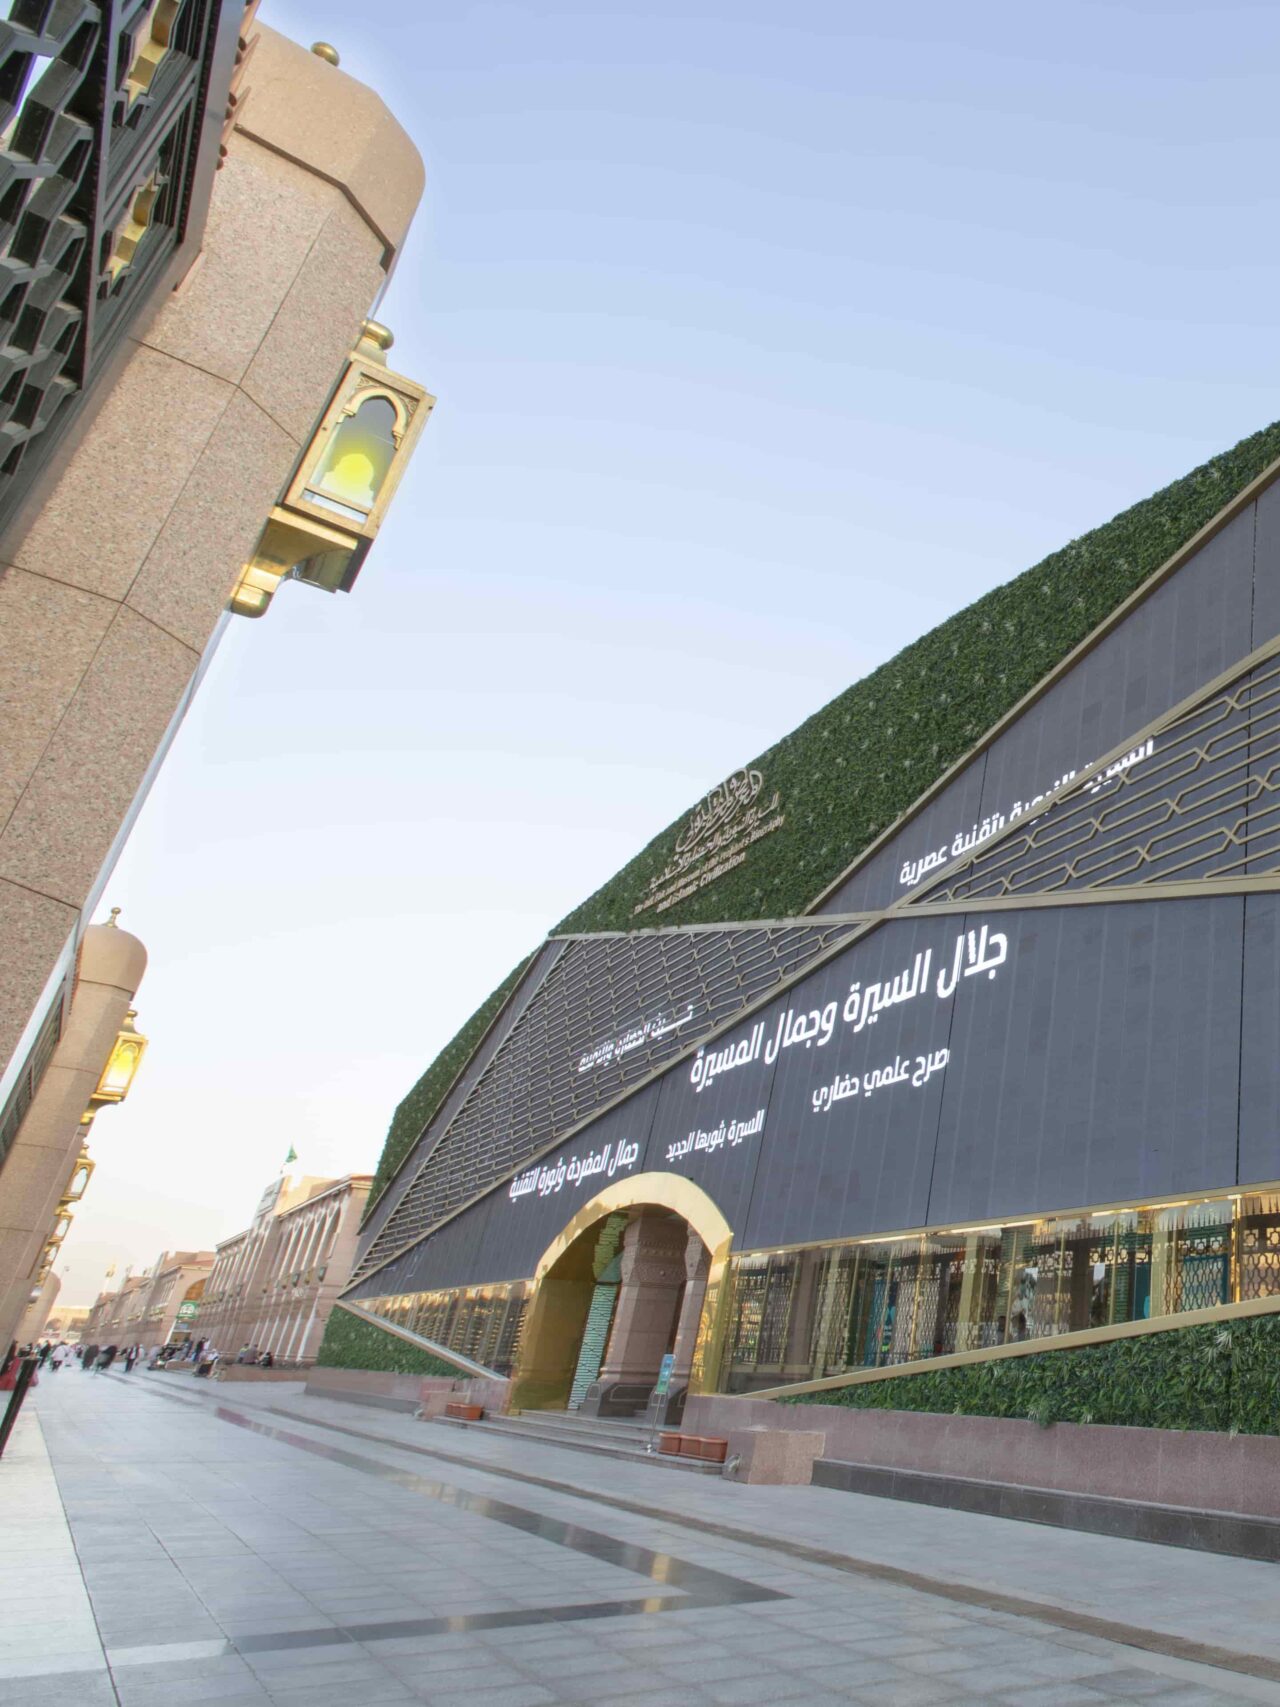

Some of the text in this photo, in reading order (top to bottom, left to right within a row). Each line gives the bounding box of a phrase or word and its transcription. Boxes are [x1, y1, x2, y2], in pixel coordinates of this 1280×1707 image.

[1082, 738, 1154, 795] السير
[899, 845, 948, 887] عصرية
[689, 924, 1008, 1093] جلال السيرة وجمال المسيرة
[811, 1047, 951, 1113] صرح علمي حضاري
[665, 1131, 696, 1163] الجديد
[727, 1109, 765, 1148] السيرة
[566, 1143, 612, 1188] المفردة
[607, 1138, 640, 1178] جمال
[508, 1165, 541, 1204] التقنية
